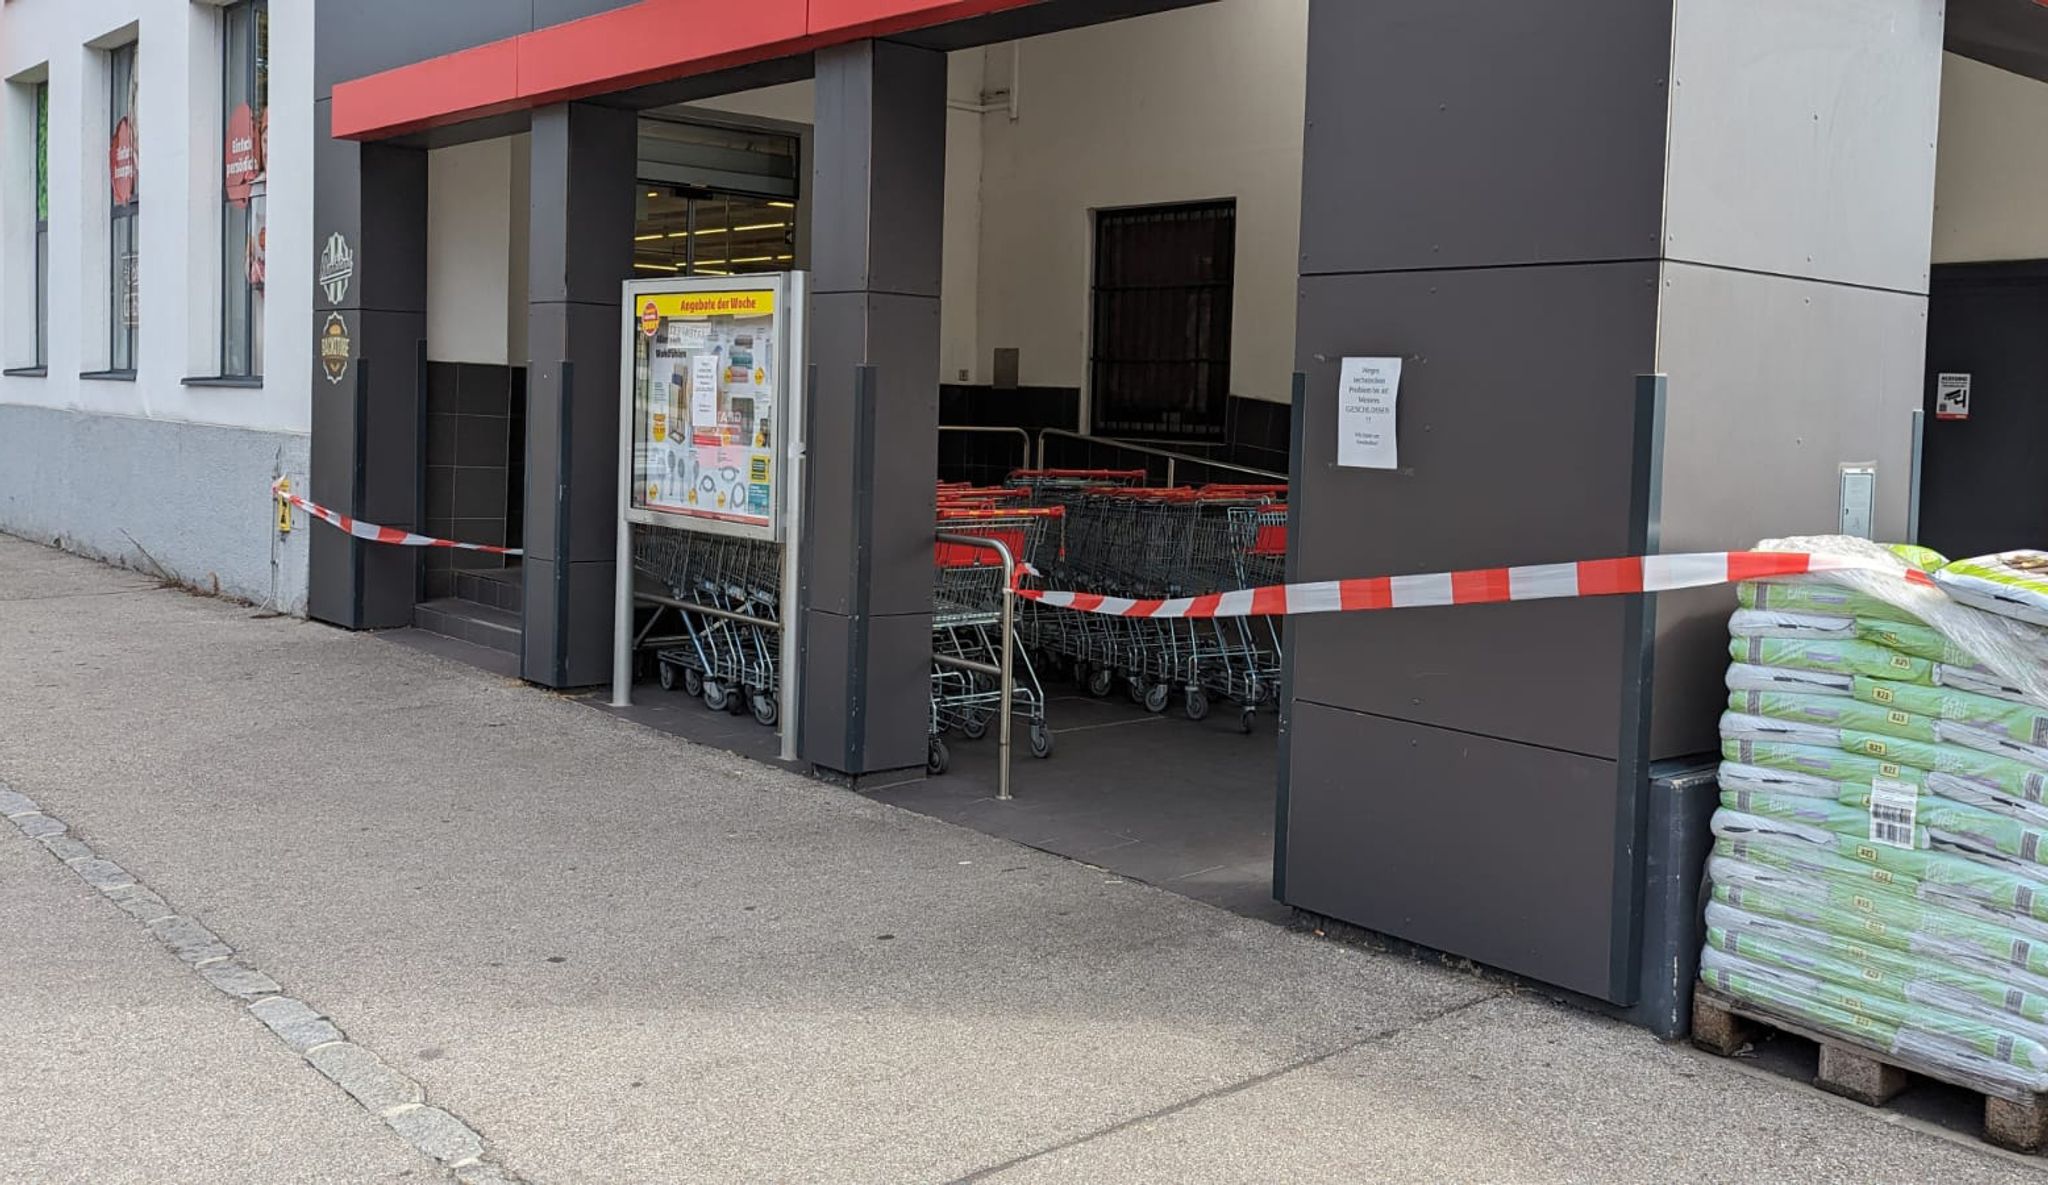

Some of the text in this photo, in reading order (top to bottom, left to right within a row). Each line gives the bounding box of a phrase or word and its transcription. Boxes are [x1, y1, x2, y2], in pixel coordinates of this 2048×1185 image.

[680, 296, 756, 313] Angebote der Woche
